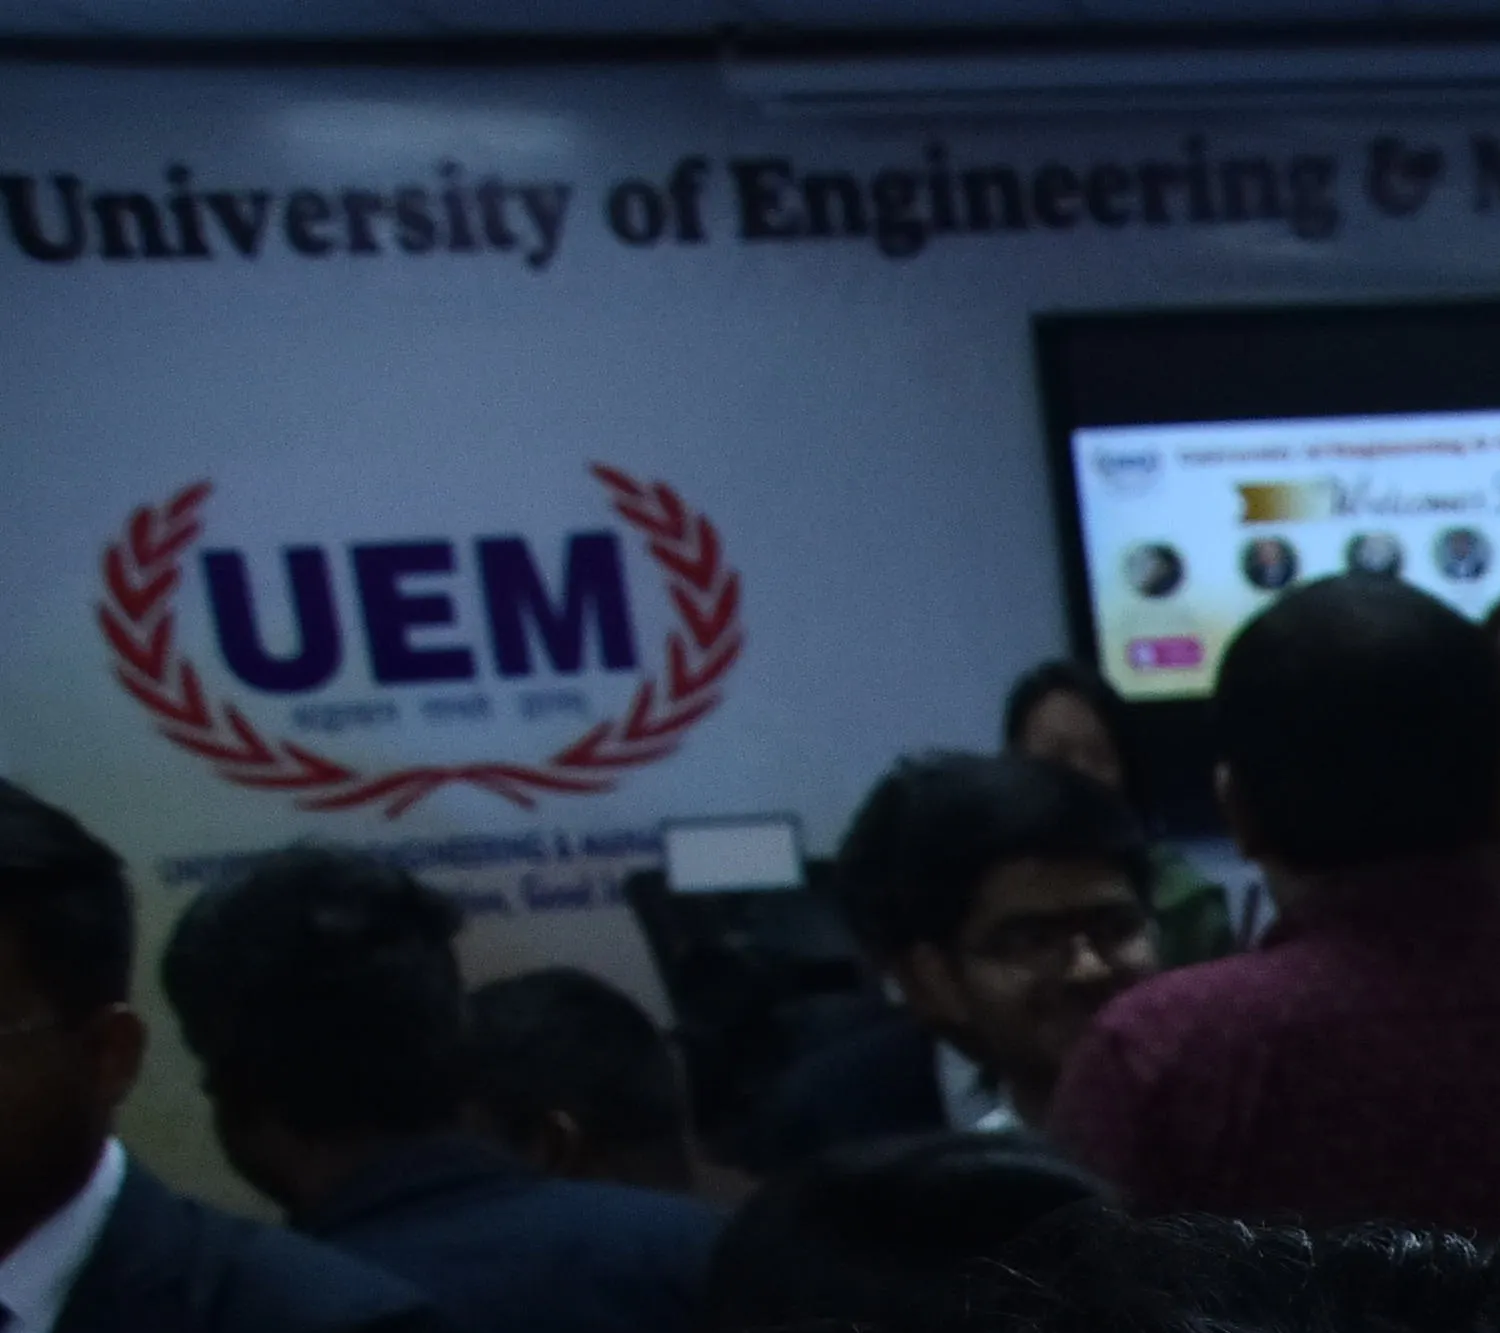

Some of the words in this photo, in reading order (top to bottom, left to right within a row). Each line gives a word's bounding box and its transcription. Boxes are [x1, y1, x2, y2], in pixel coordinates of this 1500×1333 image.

[0, 160, 572, 269] University
[607, 157, 710, 246] of
[729, 138, 1340, 259] Engineering
[1368, 136, 1442, 215] &
[202, 532, 640, 693] UEM
